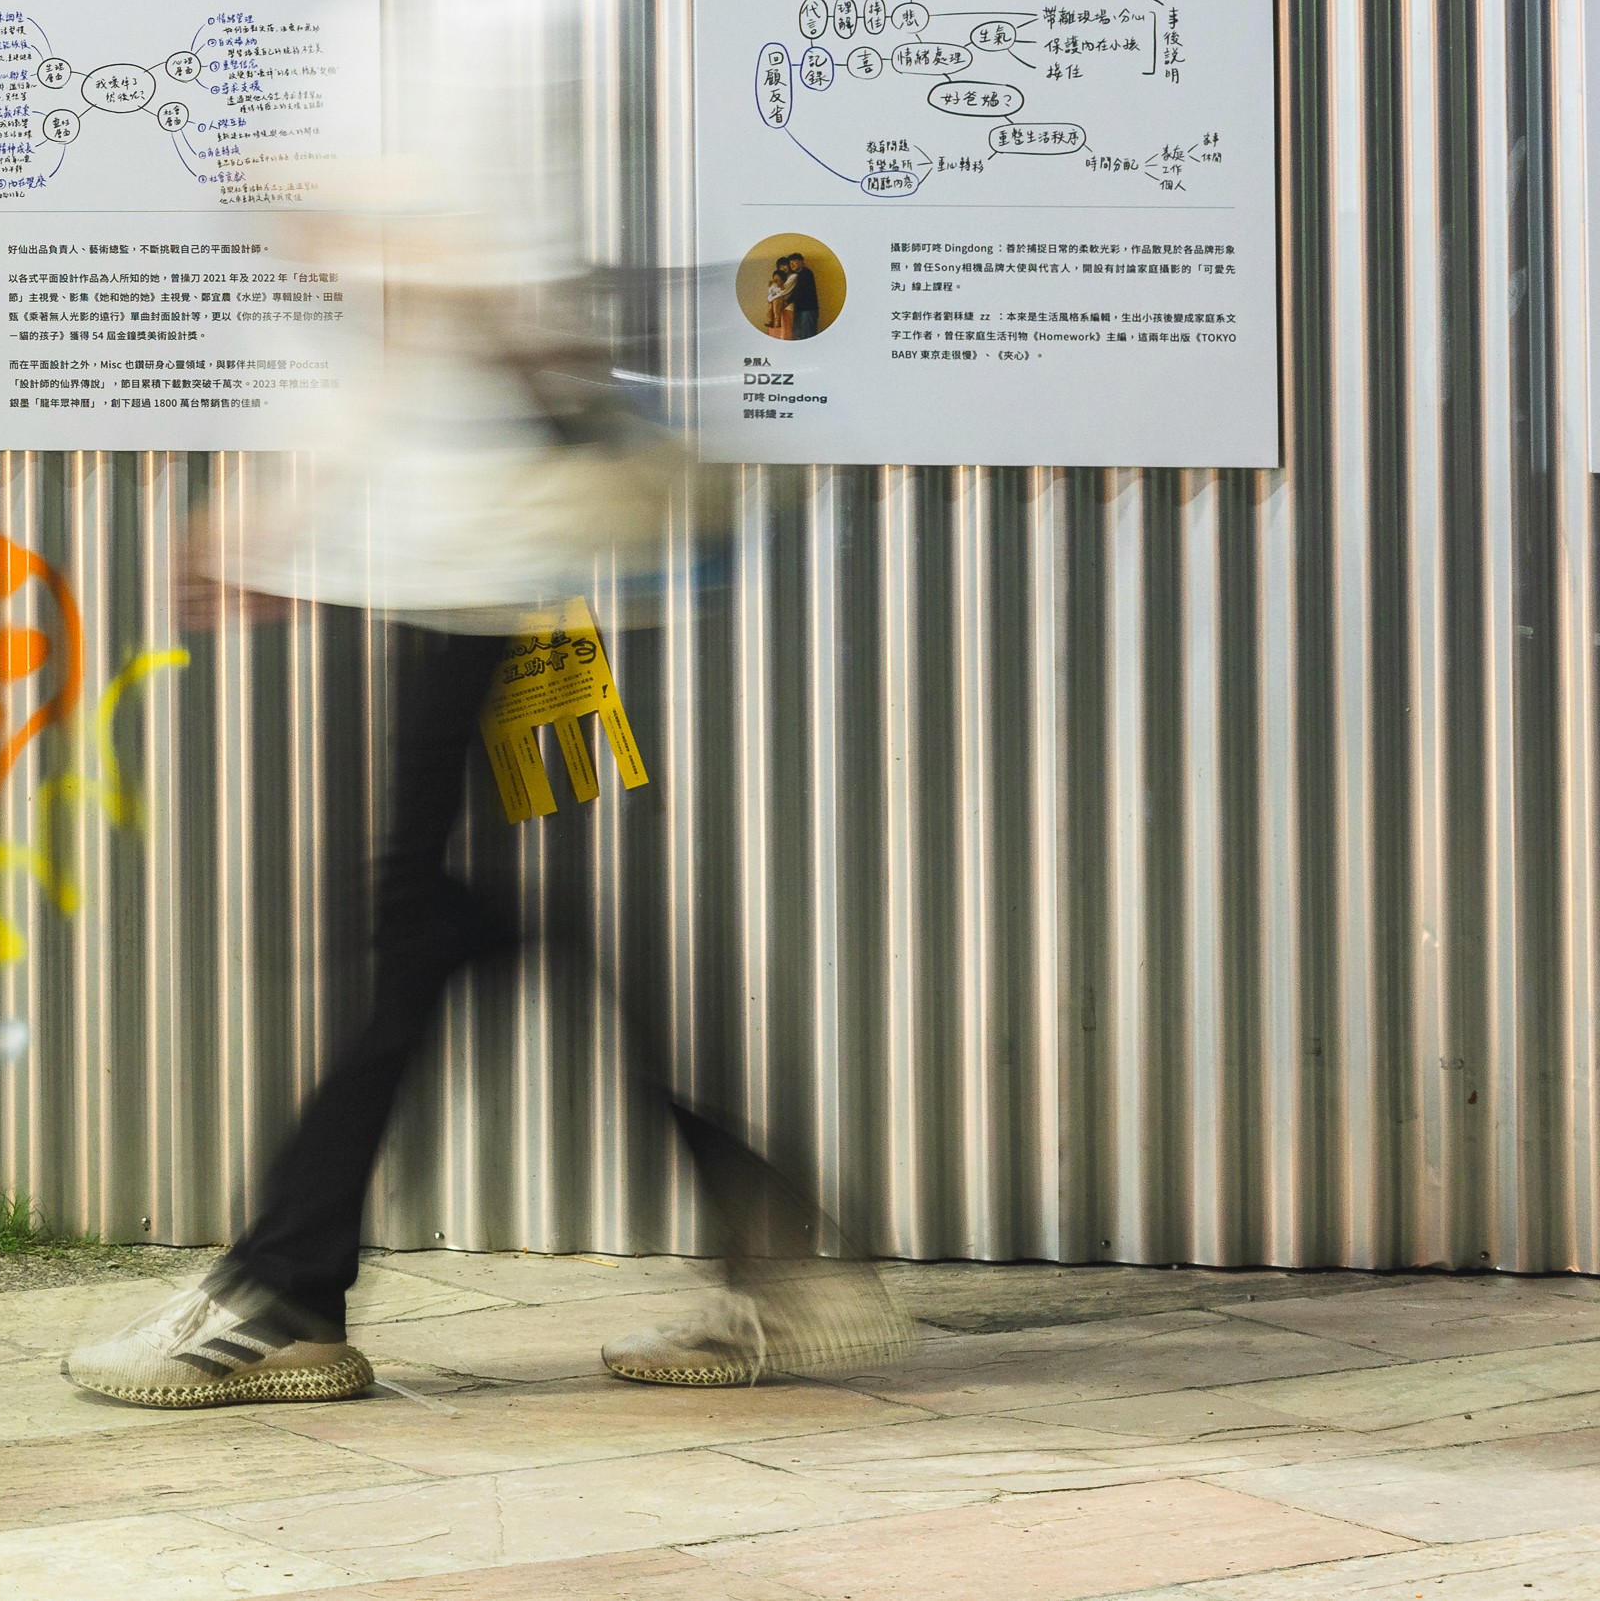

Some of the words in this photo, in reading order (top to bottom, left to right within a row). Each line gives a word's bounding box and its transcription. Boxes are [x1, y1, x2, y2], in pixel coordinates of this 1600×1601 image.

[801, 1, 821, 35] 代言
[901, 11, 918, 27] 悲
[980, 26, 1011, 43] 生氣
[1044, 35, 1140, 55] 保護內在小孩
[1164, 7, 1185, 84] 事後說明
[857, 51, 875, 73] 喜
[898, 47, 965, 66] 情緒處理
[805, 55, 829, 86] 記錄
[764, 52, 787, 124] 回顧反省
[998, 130, 1079, 146] 重整生活秩序
[1161, 144, 1185, 161] 家庭
[1086, 157, 1139, 171] 時間分配
[1163, 164, 1182, 175] 工作
[1160, 180, 1186, 191] 個人
[203, 273, 227, 283] 2021
[228, 272, 250, 283] 年及
[251, 273, 276, 283] 2022
[277, 272, 339, 283] 年「台北電影
[890, 281, 961, 292] 決」線上課程。
[743, 357, 771, 366] 參展人
[743, 373, 795, 386] DDZZ
[154, 398, 178, 408] 1800
[179, 398, 269, 408] 萬台幣銷售的佳績。
[742, 392, 766, 403] 叮咚
[768, 393, 828, 405] Dingdong
[503, 651, 569, 683] 互助會
